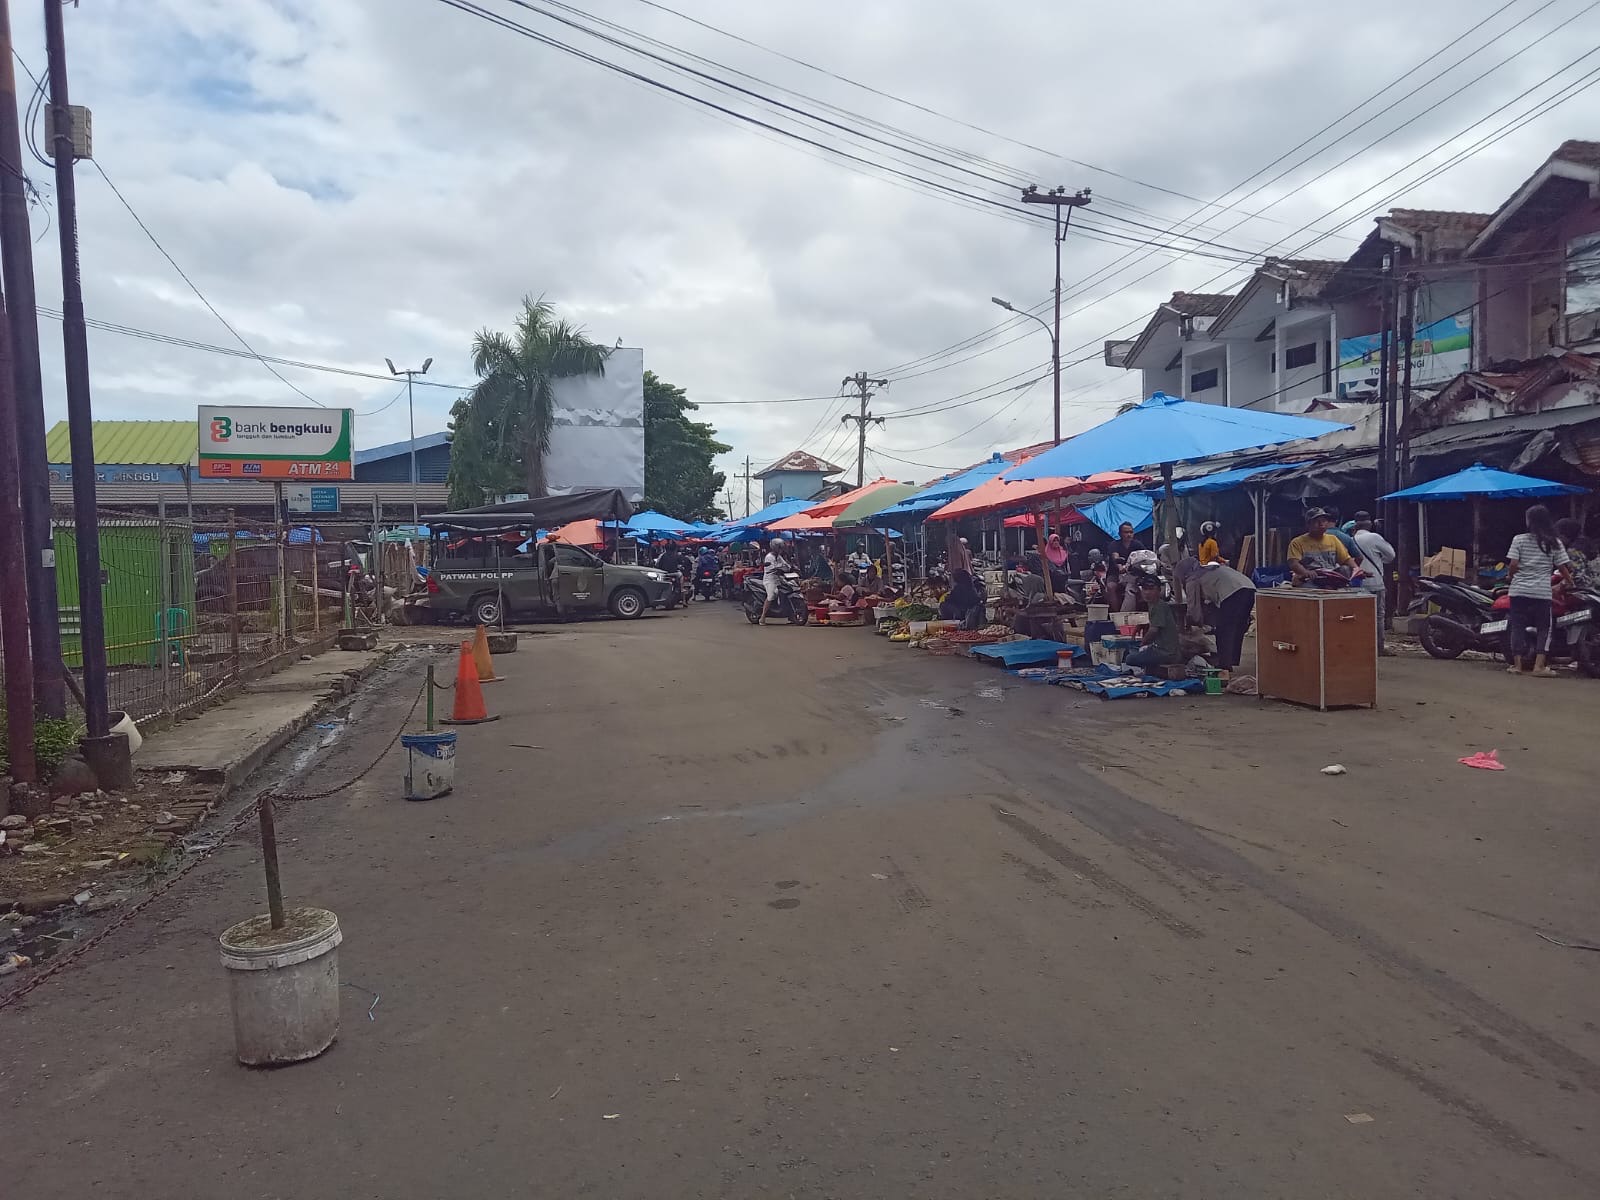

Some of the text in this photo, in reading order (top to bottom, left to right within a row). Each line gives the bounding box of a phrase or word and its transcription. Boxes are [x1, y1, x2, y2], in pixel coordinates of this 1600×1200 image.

[235, 421, 332, 436] bank bengkulu
[288, 462, 339, 475] ATM 24
[440, 573, 478, 581] PATWAL
